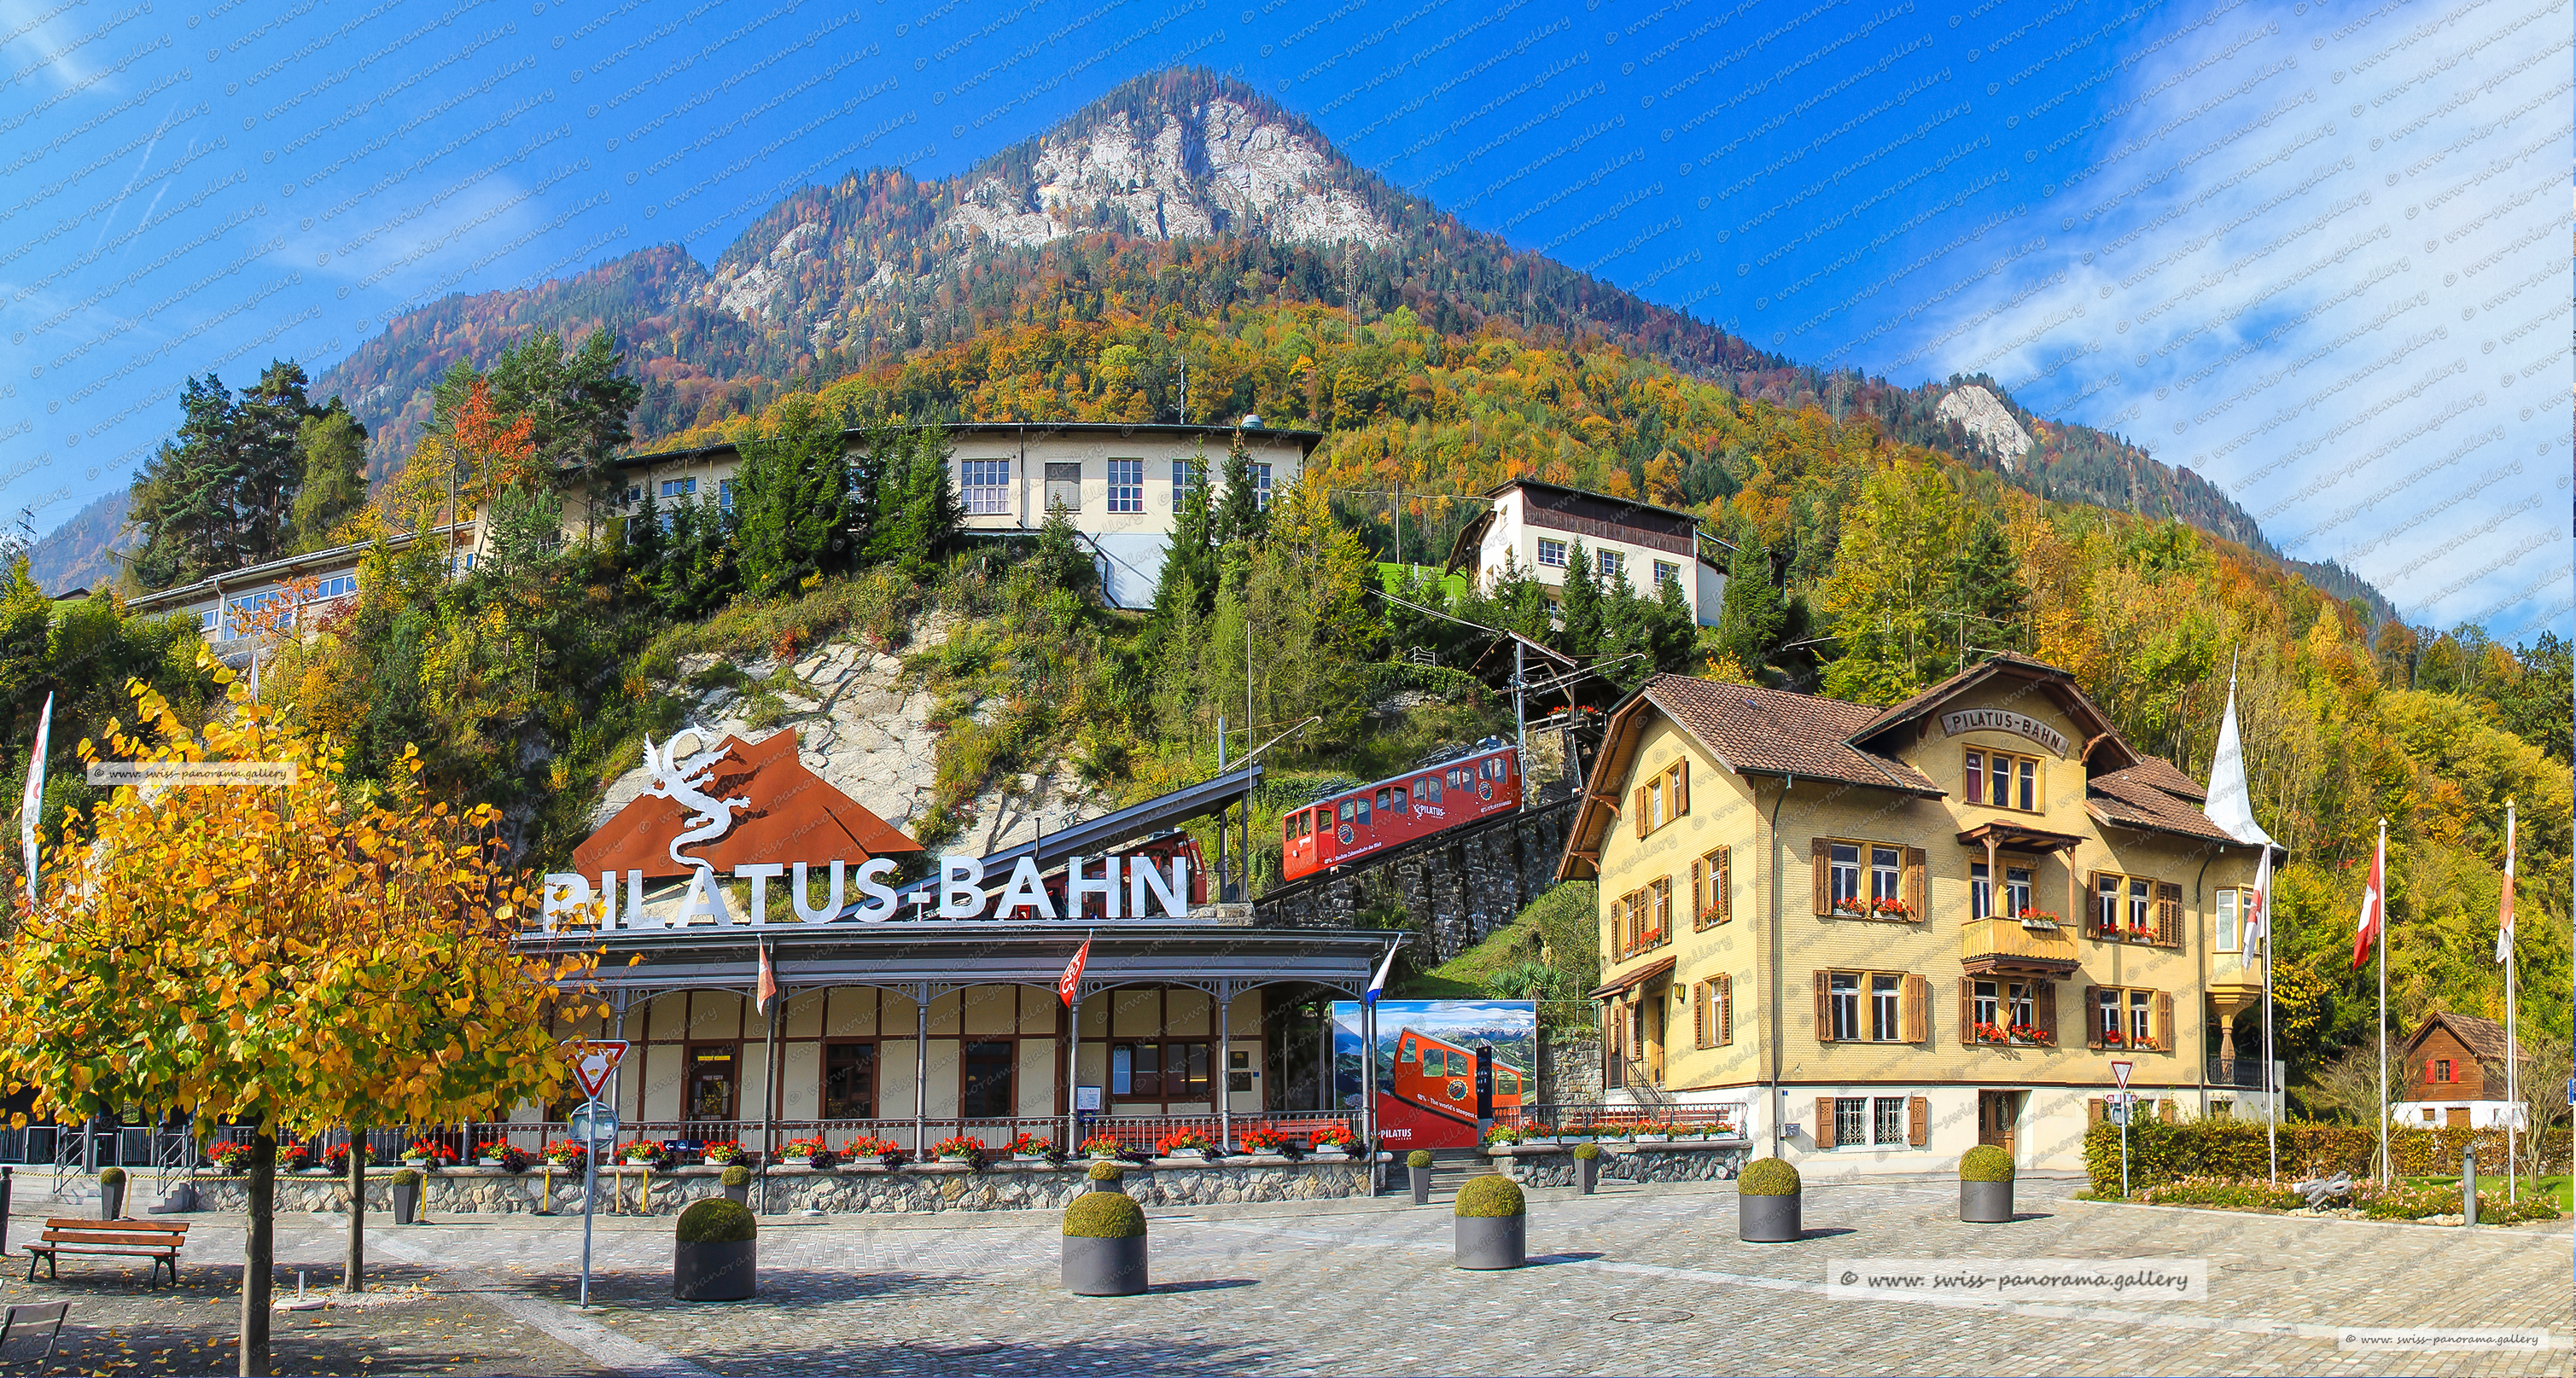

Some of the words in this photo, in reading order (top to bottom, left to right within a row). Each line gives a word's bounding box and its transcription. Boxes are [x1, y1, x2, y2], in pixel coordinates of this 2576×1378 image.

[1951, 712, 2060, 749] PILATUS-BAHN
[1420, 804, 1443, 817] PILATUS
[544, 856, 1187, 933] PILATUS-BAHN
[1430, 1097, 1438, 1107] The
[1439, 1101, 1455, 1112] world's
[1455, 1107, 1474, 1119] steepest
[1380, 1128, 1412, 1139] PILATUS
